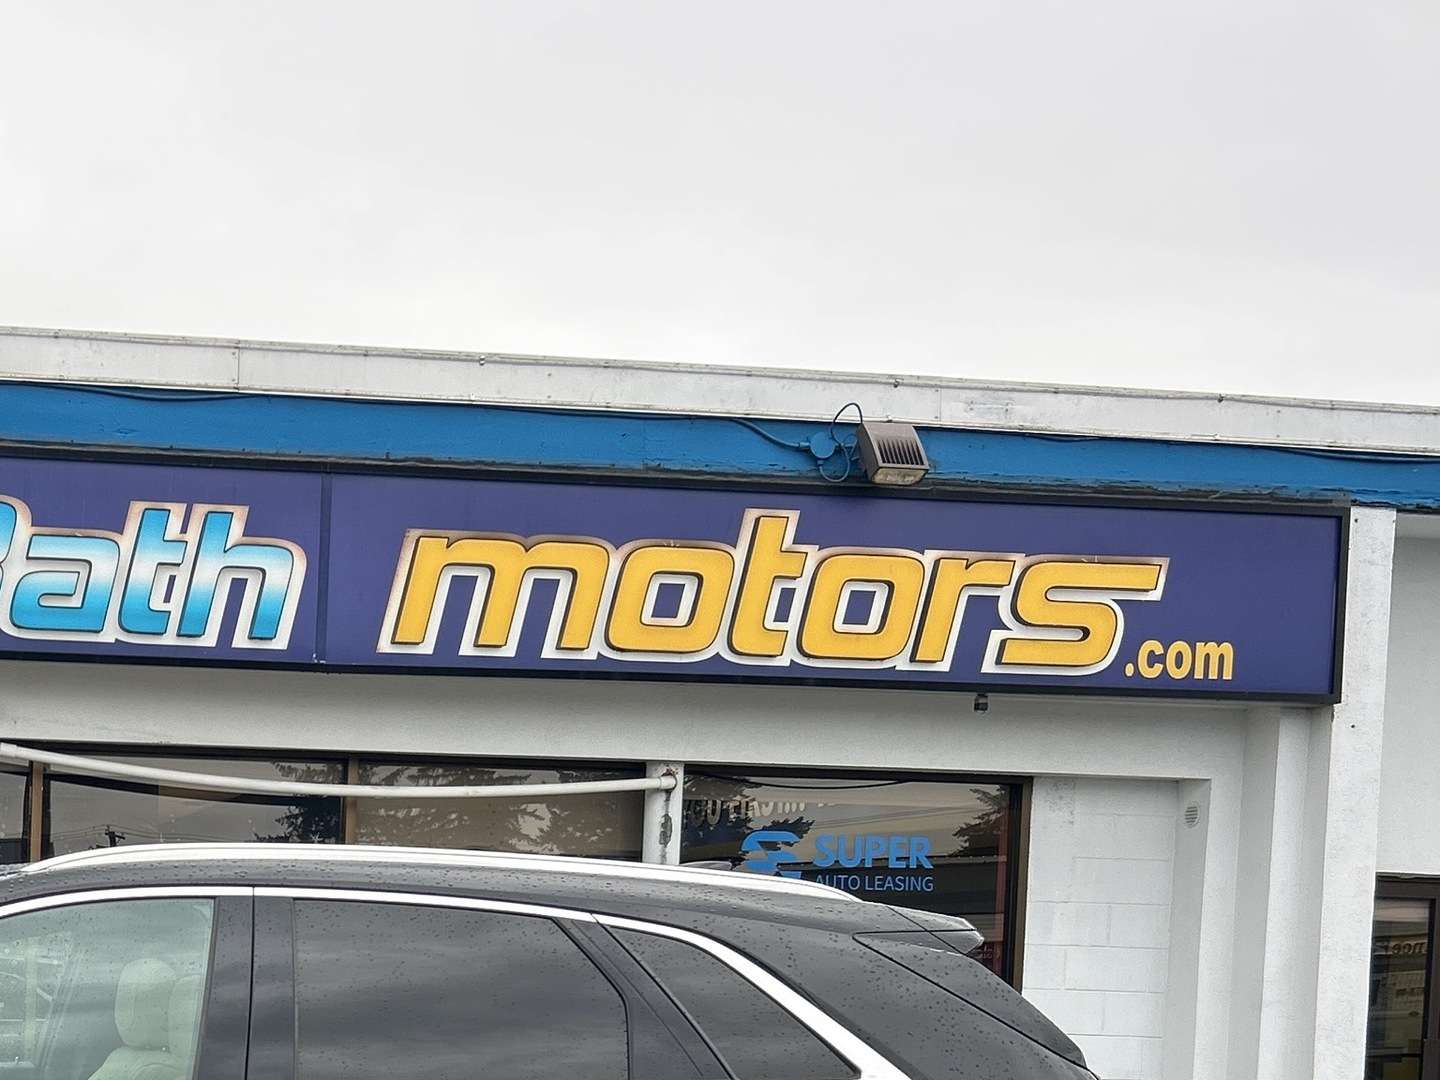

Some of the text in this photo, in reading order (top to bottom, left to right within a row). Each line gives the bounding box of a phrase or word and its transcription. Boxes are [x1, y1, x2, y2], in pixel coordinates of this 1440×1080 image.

[376, 508, 1171, 676] motors
[1124, 639, 1234, 680] .com
[813, 832, 934, 869] SUPER
[816, 874, 934, 892] AUTO LEASING
